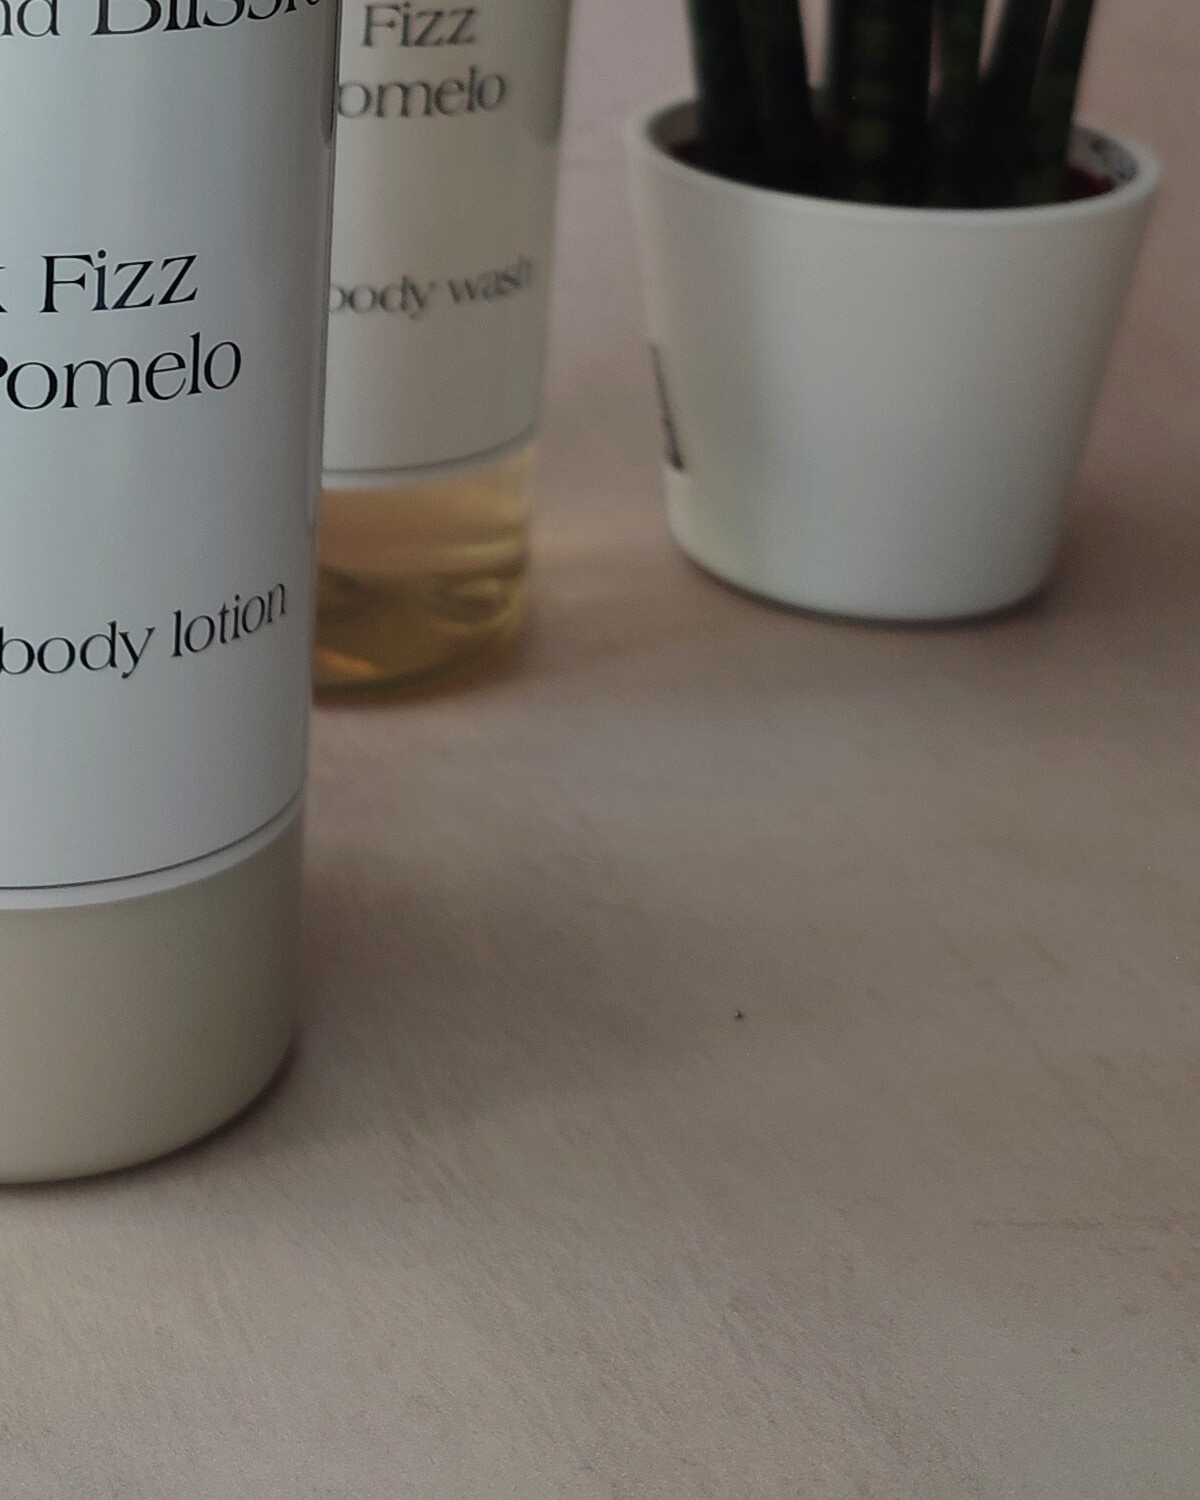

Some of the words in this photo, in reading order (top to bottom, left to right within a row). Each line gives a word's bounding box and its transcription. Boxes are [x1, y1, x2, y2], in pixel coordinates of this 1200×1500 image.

[362, 1, 477, 48] Fizz
[337, 64, 508, 118] omelo
[40, 249, 200, 313] Fizz
[171, 581, 289, 660] lotion
